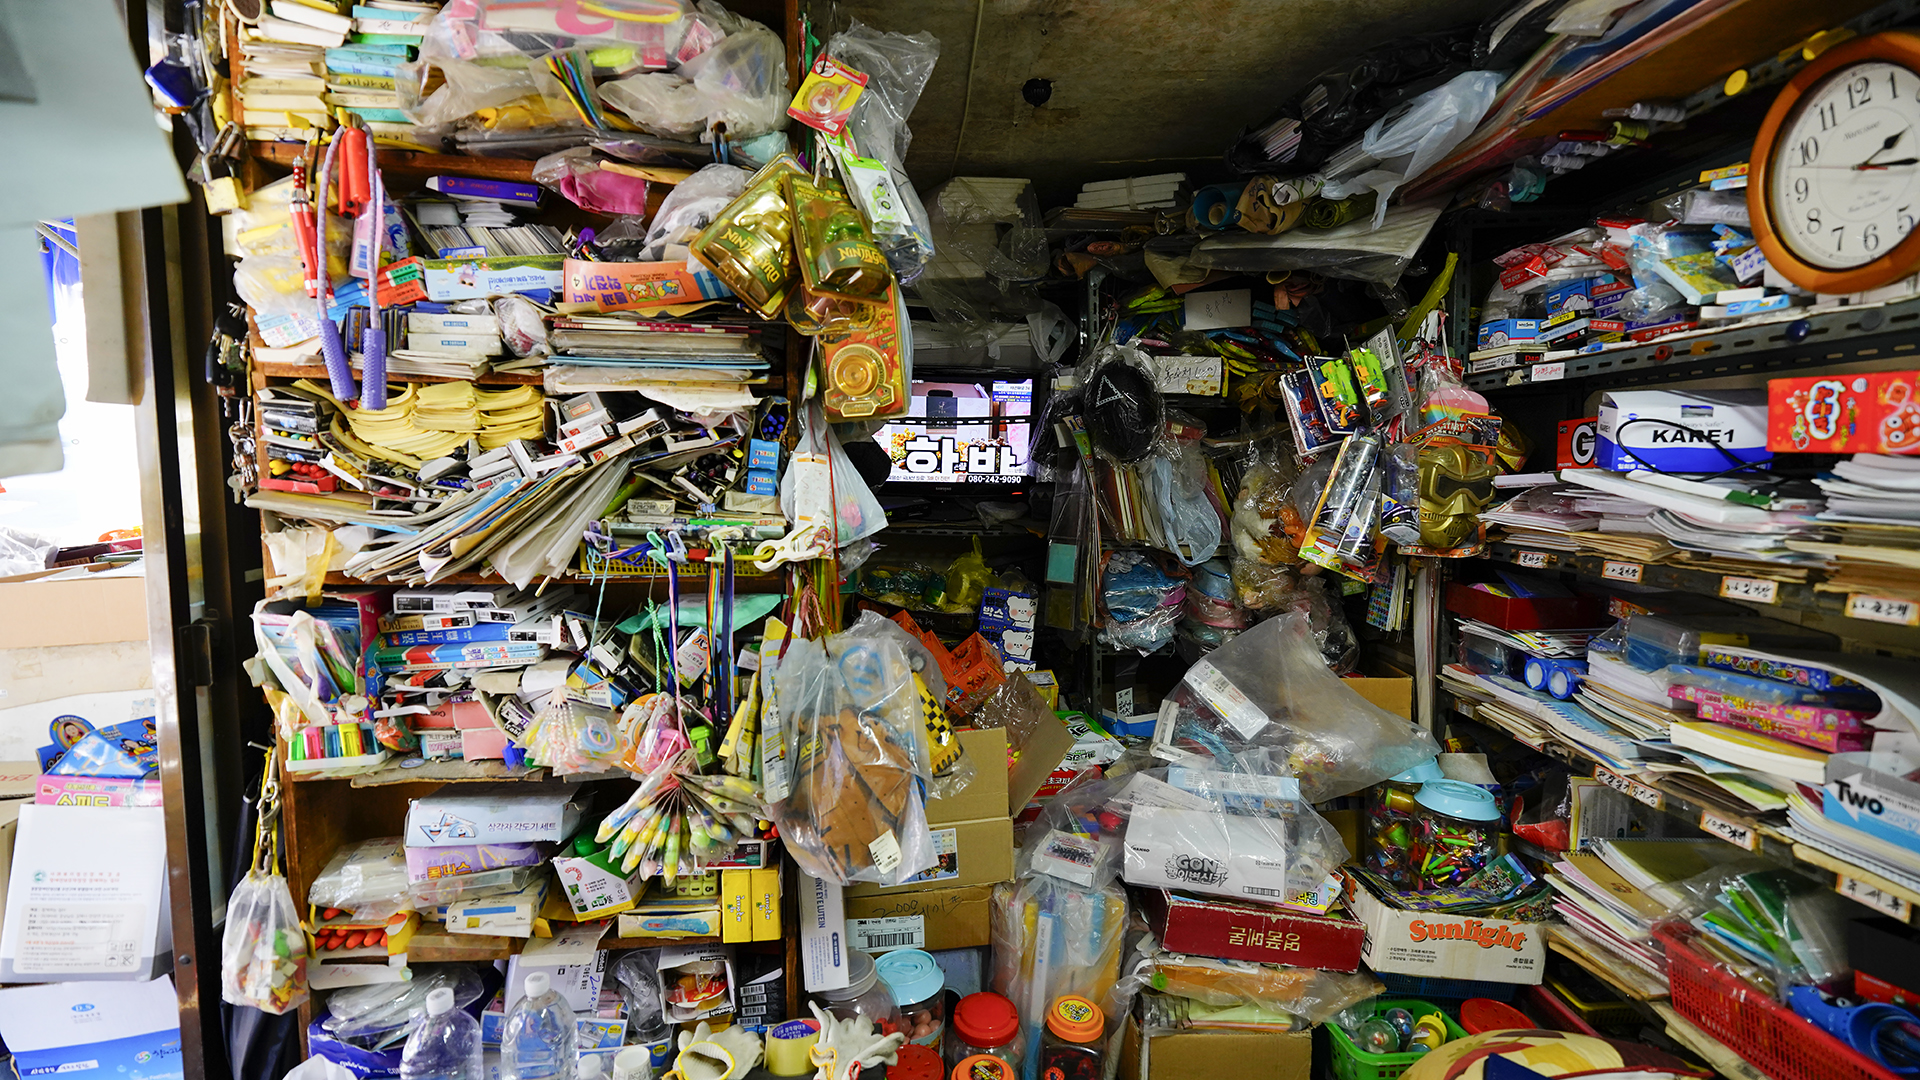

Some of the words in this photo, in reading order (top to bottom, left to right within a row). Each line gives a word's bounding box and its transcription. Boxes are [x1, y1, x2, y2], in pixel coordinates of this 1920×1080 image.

[1846, 76, 1871, 110] 12
[1890, 72, 1899, 99] 1
[1819, 102, 1838, 131] 11
[1800, 136, 1819, 166] 10
[1795, 177, 1809, 203] 9
[1806, 208, 1821, 234] 8
[1897, 205, 1914, 235] 5
[1831, 226, 1845, 251] 7
[1864, 224, 1879, 251] 6
[1652, 429, 1735, 443] KARE1
[968, 475, 1022, 484] 080-242-9090
[982, 606, 1004, 619] 박스
[1835, 780, 1884, 815] Two
[513, 822, 539, 832] 각도기
[540, 822, 556, 832] 세트
[1166, 868, 1227, 886] 팽이변신카
[1174, 855, 1218, 875] GON
[816, 892, 825, 904] EYE
[873, 899, 918, 917] 2000
[451, 915, 457, 923] 2
[816, 905, 825, 929] LUTEIN
[1228, 926, 1300, 952] 명품메론
[1409, 919, 1527, 952] Sunlight
[597, 951, 607, 972] Scotch
